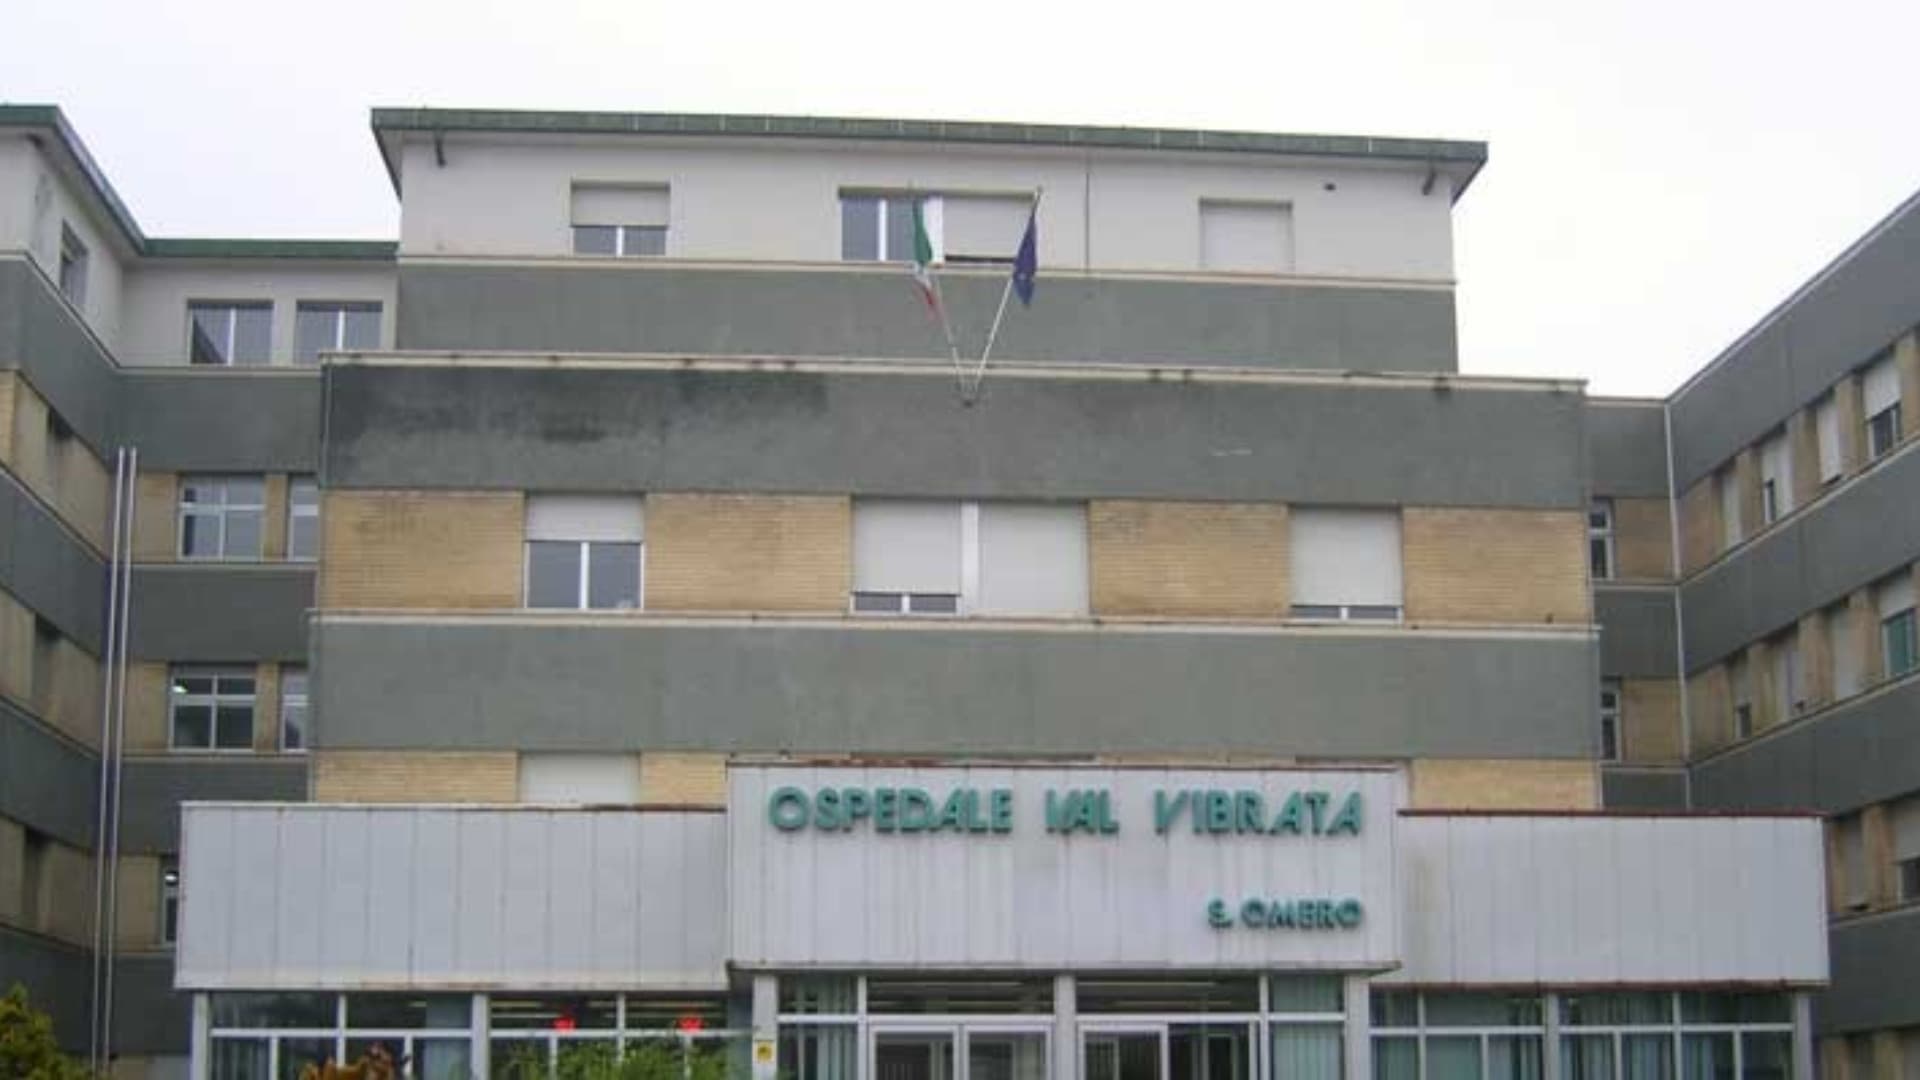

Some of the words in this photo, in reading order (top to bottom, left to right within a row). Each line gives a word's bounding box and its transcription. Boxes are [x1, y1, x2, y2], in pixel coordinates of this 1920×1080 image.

[768, 786, 1013, 834] OSPEDALE
[1045, 789, 1119, 834] VAL
[1155, 789, 1363, 836] VIBRATA
[1240, 899, 1363, 928] OMERO
